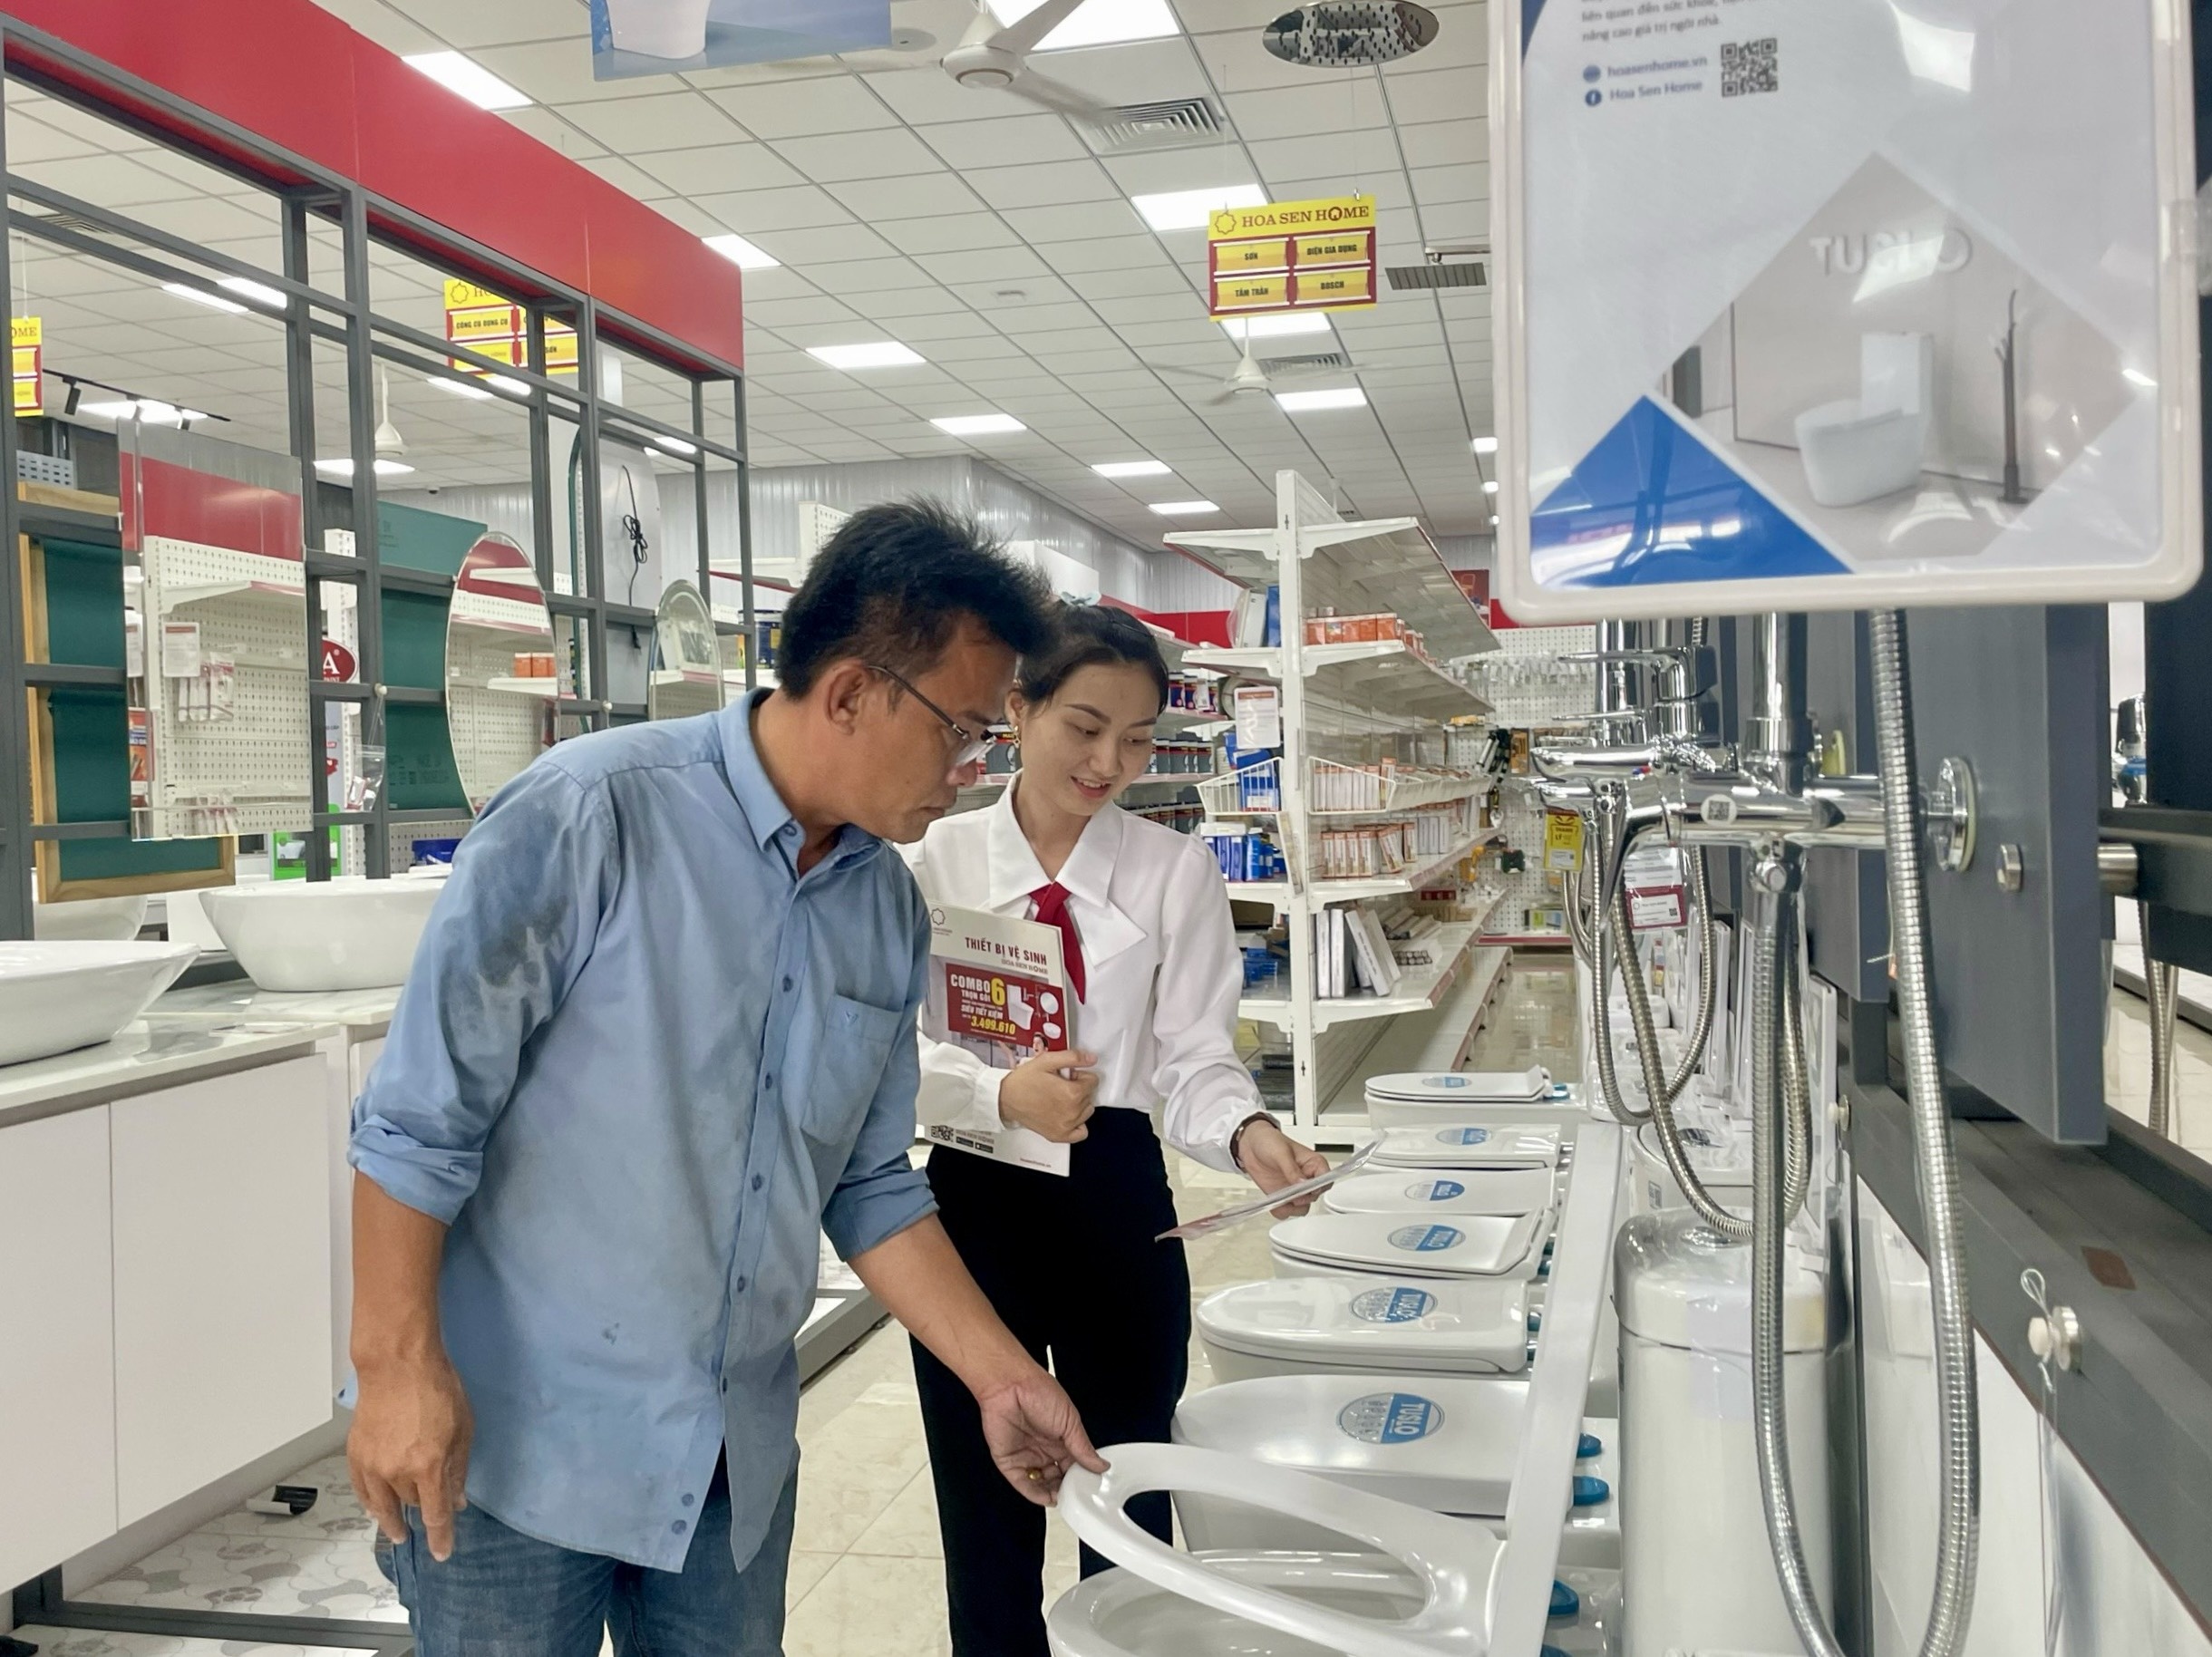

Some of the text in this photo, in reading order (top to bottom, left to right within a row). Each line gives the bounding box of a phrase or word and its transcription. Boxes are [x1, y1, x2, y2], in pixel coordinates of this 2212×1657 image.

[1606, 8, 1634, 20] quan
[1613, 28, 1632, 39] cao
[1635, 24, 1652, 37] giá
[1671, 17, 1694, 32] ngôi
[1607, 56, 1707, 77] hoasenhome.vn
[1610, 82, 1702, 100] Hoa Sen Home
[1242, 206, 1370, 228] HOA SEN HOME
[1320, 281, 1344, 290] BOSCH
[965, 936, 1047, 965] THIẾT BỊ VỆ SINH
[950, 974, 991, 993] COMBO
[991, 977, 1005, 1006] 6
[971, 1015, 1016, 1035] 3.499.610
[1393, 1403, 1426, 1435] TUSLO
